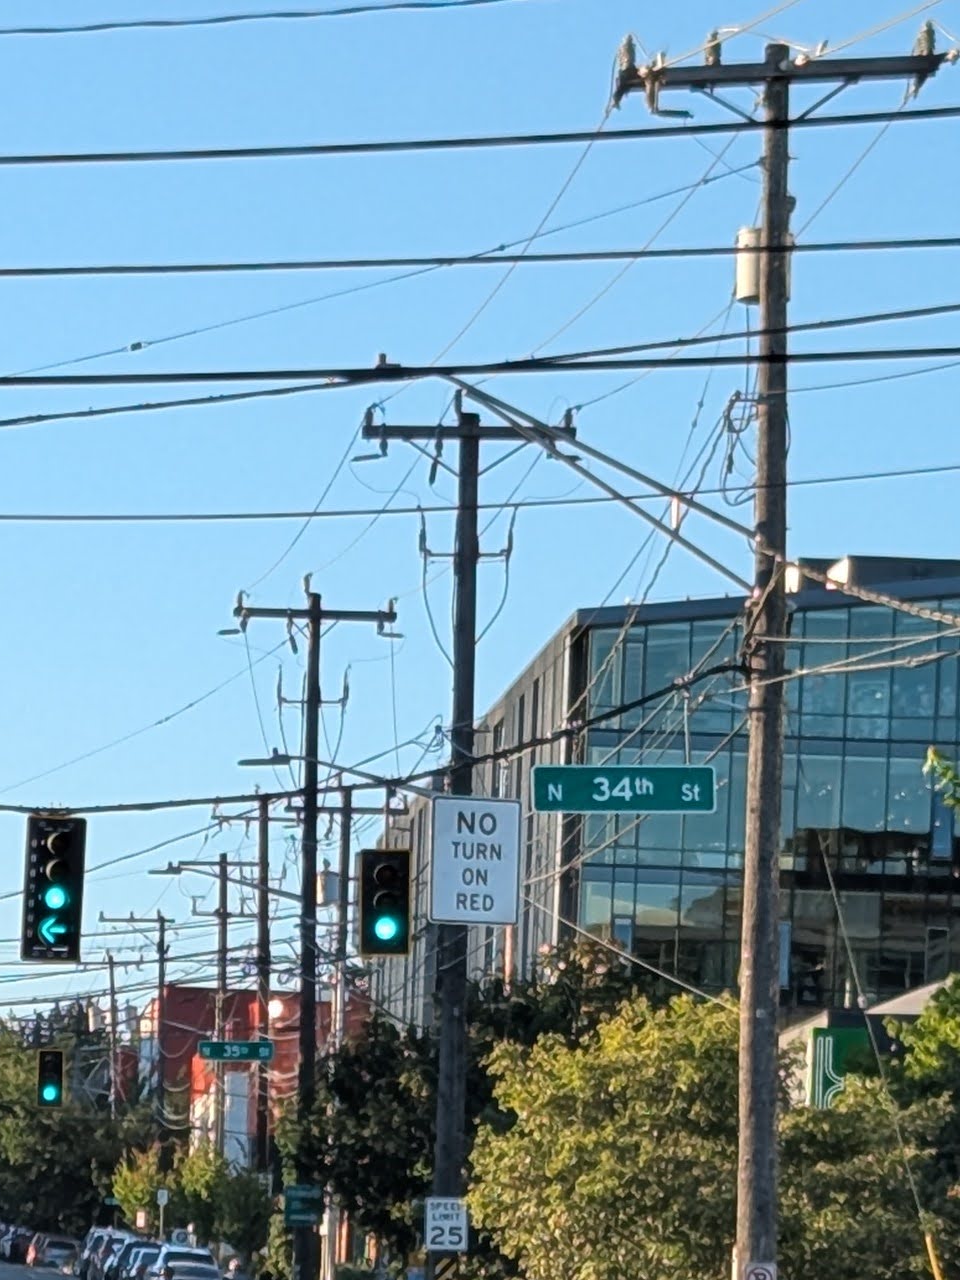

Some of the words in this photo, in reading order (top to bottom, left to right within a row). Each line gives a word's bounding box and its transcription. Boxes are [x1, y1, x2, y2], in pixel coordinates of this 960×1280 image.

[547, 783, 563, 802] N
[591, 776, 654, 802] 34th
[681, 783, 700, 802] St
[457, 810, 497, 836] NO
[451, 840, 502, 861] TURN
[461, 867, 488, 886] ON
[456, 892, 494, 912] RED
[432, 1213, 460, 1221] LIMIT
[430, 1226, 463, 1245] 25
